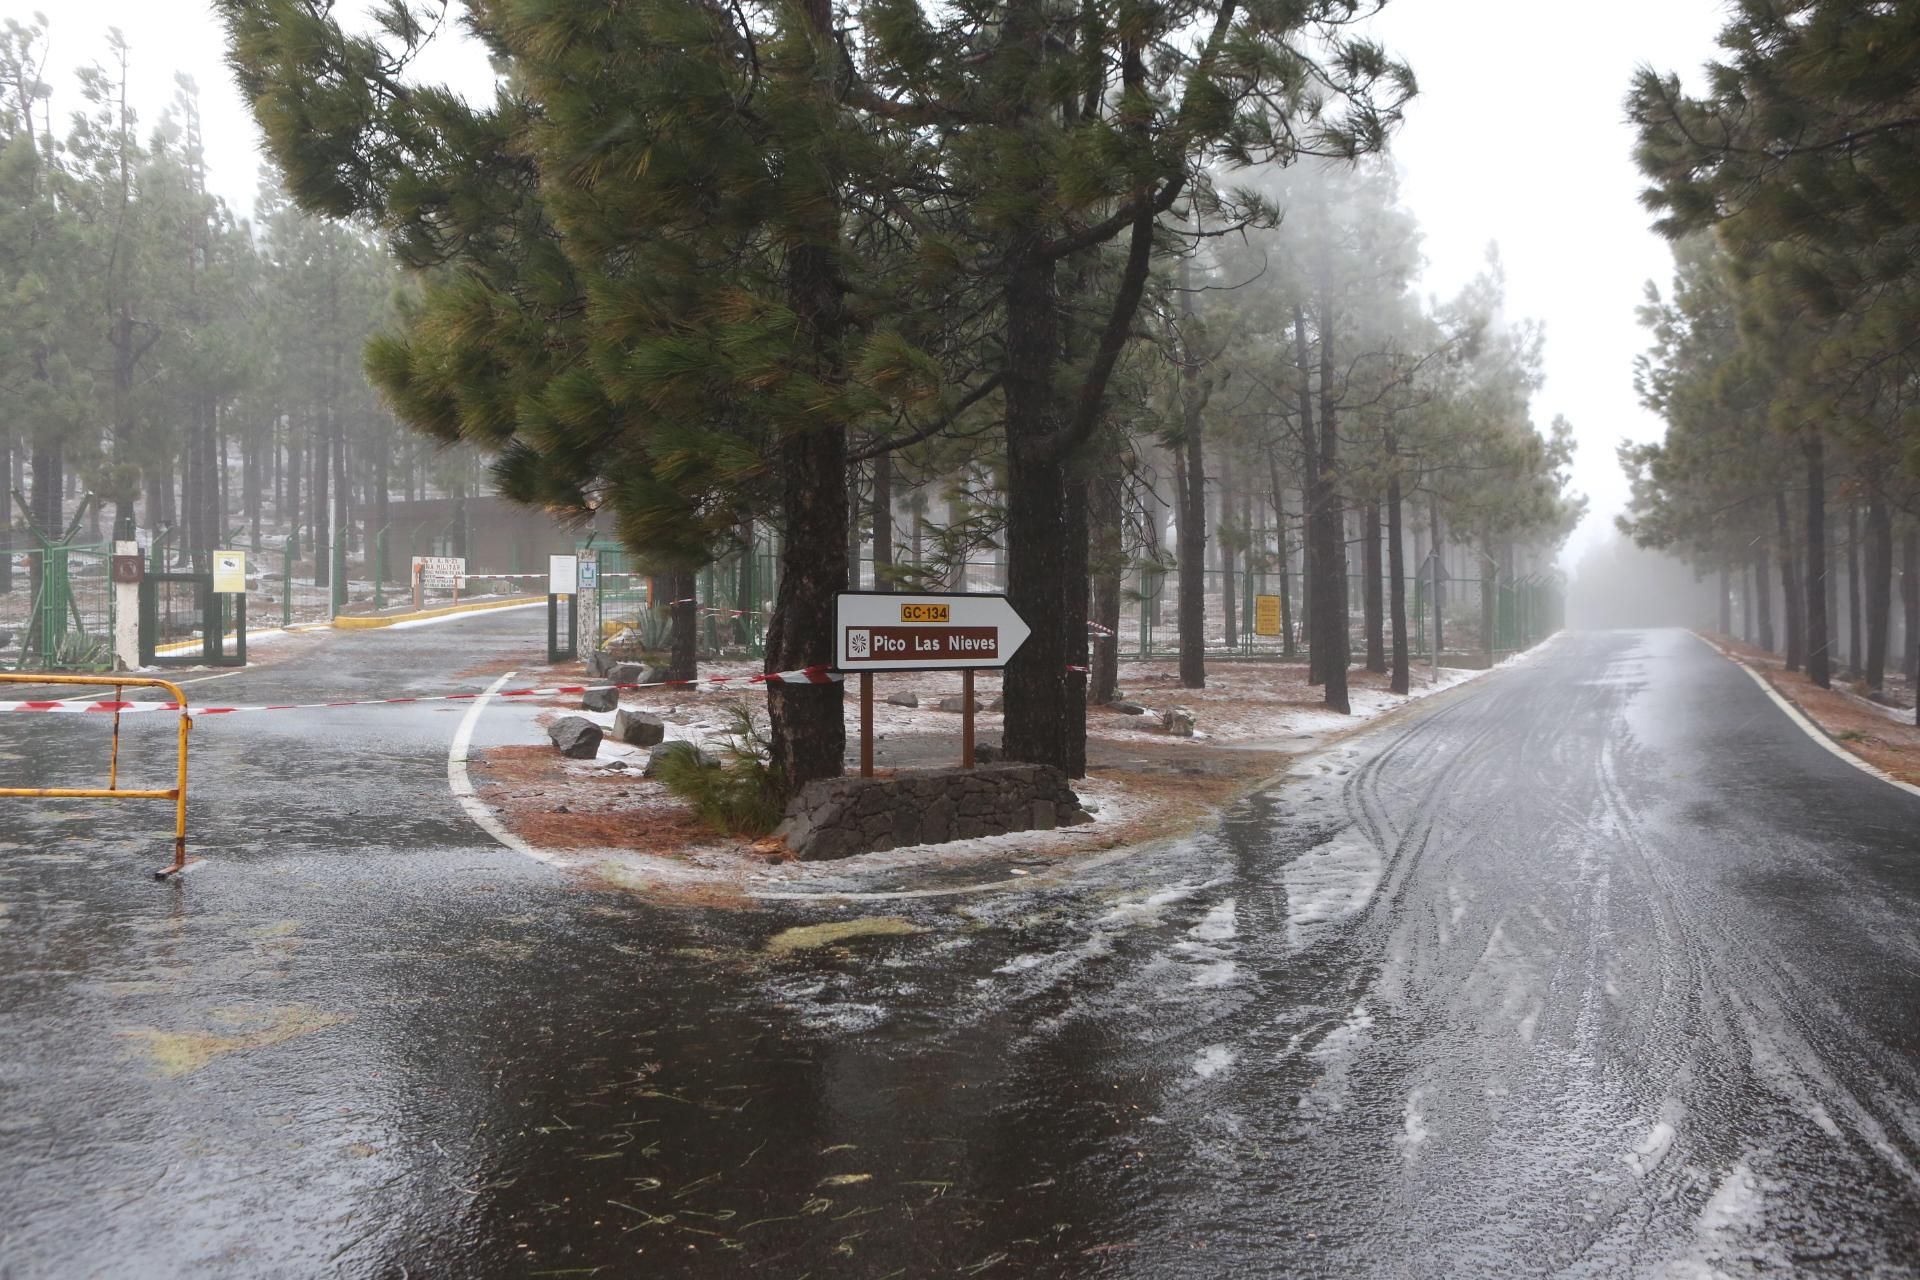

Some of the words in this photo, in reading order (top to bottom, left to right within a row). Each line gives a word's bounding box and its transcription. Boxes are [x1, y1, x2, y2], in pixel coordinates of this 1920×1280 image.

[903, 606, 947, 619] GC-134
[874, 635, 906, 651] Pico
[915, 635, 940, 651] Las
[949, 635, 996, 650] Nieves
